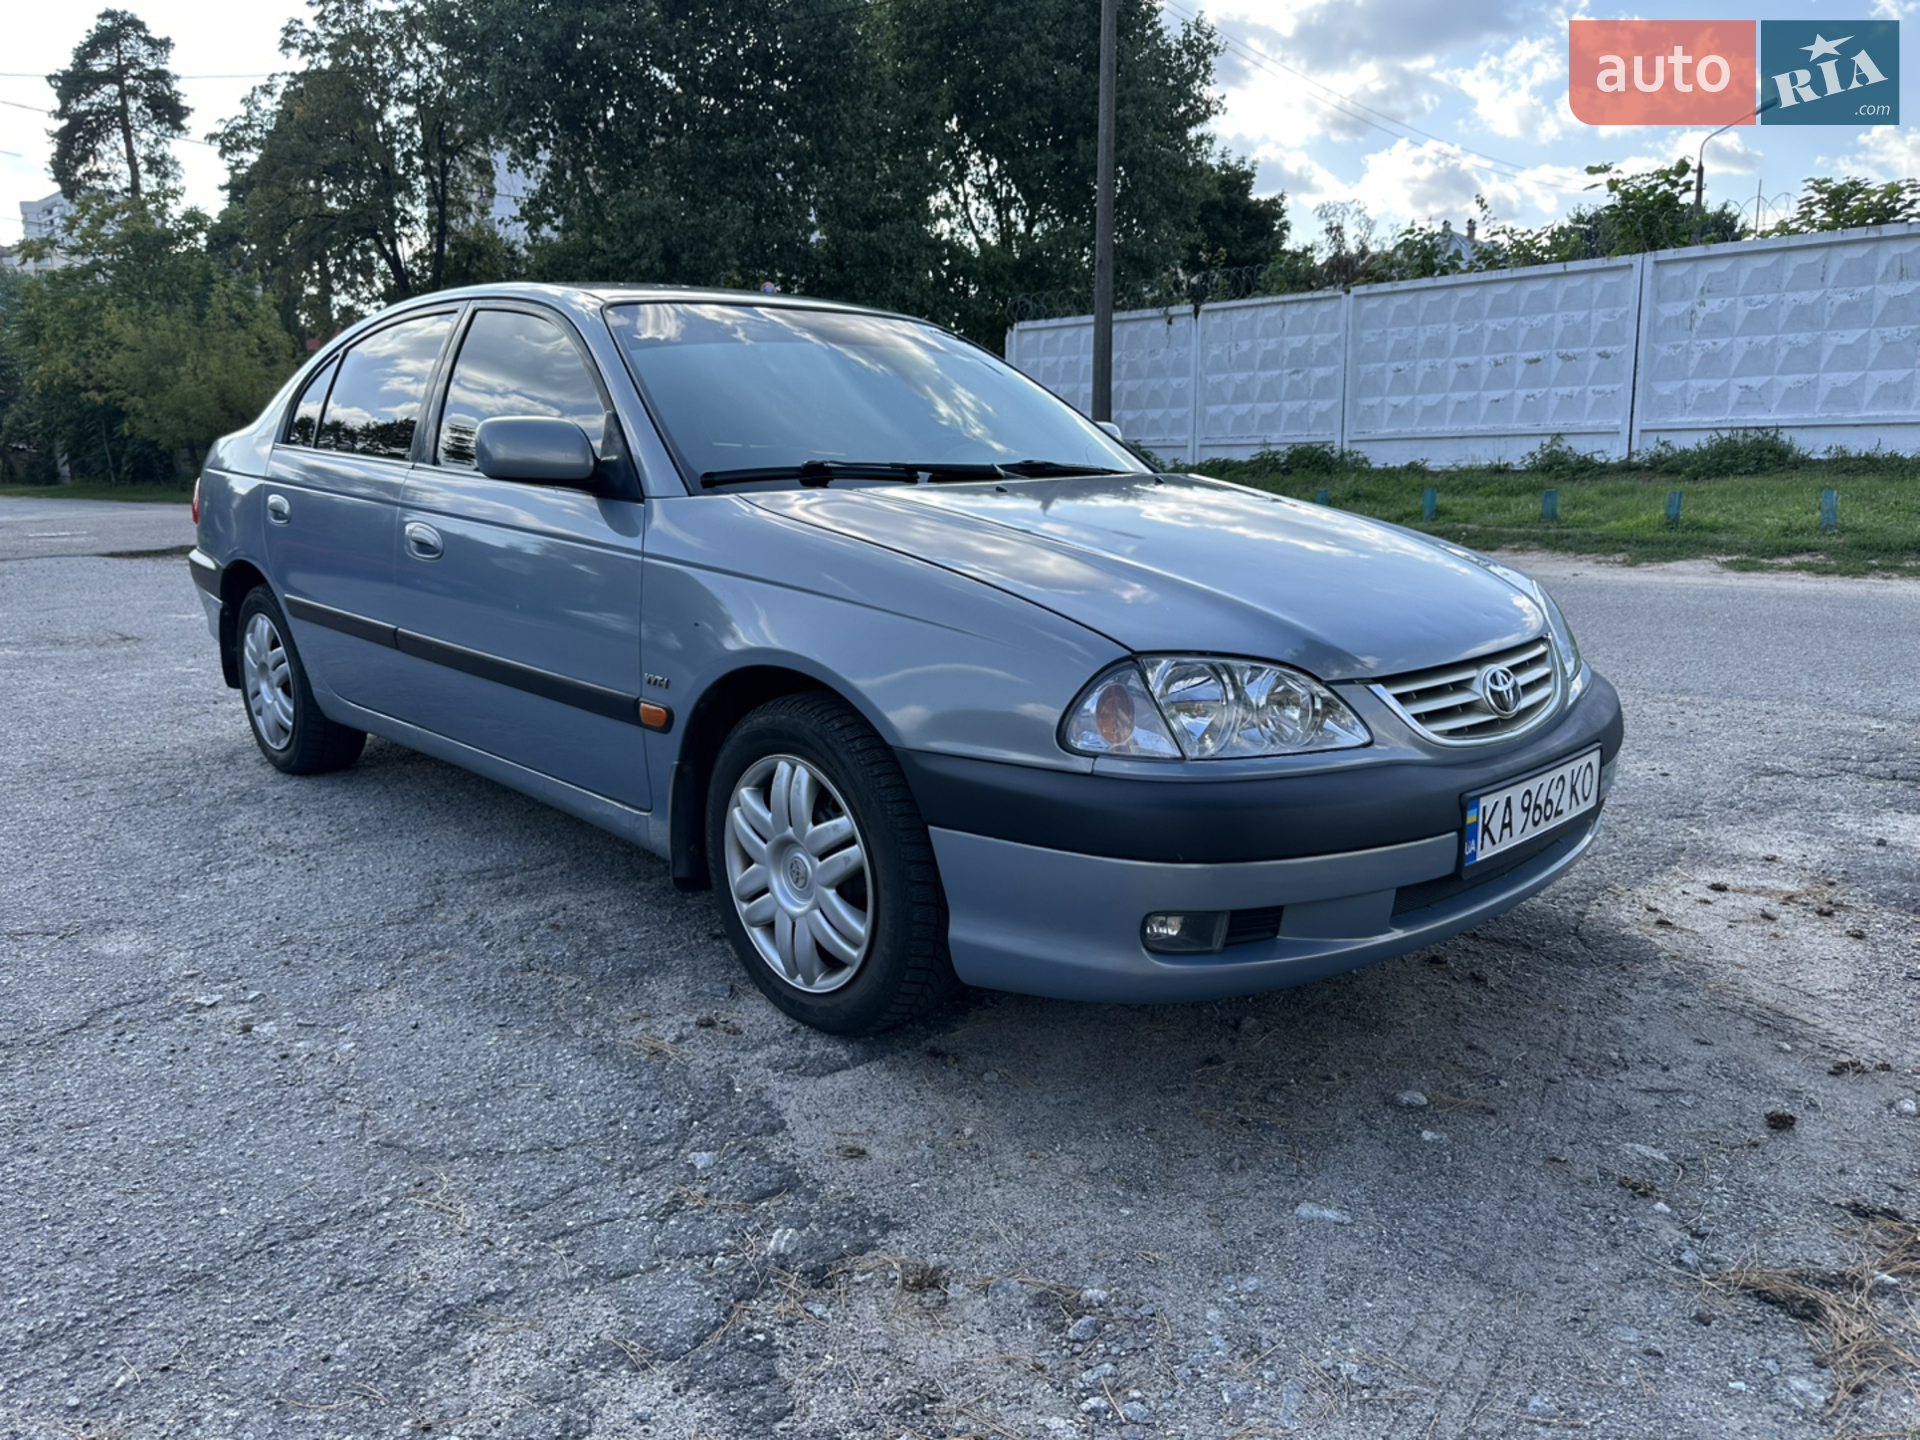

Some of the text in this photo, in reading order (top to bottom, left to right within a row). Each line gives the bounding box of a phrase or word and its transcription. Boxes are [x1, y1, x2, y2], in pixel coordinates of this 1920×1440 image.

[1480, 760, 1594, 852] KA 9662 KO
[1464, 839, 1476, 856] UA
